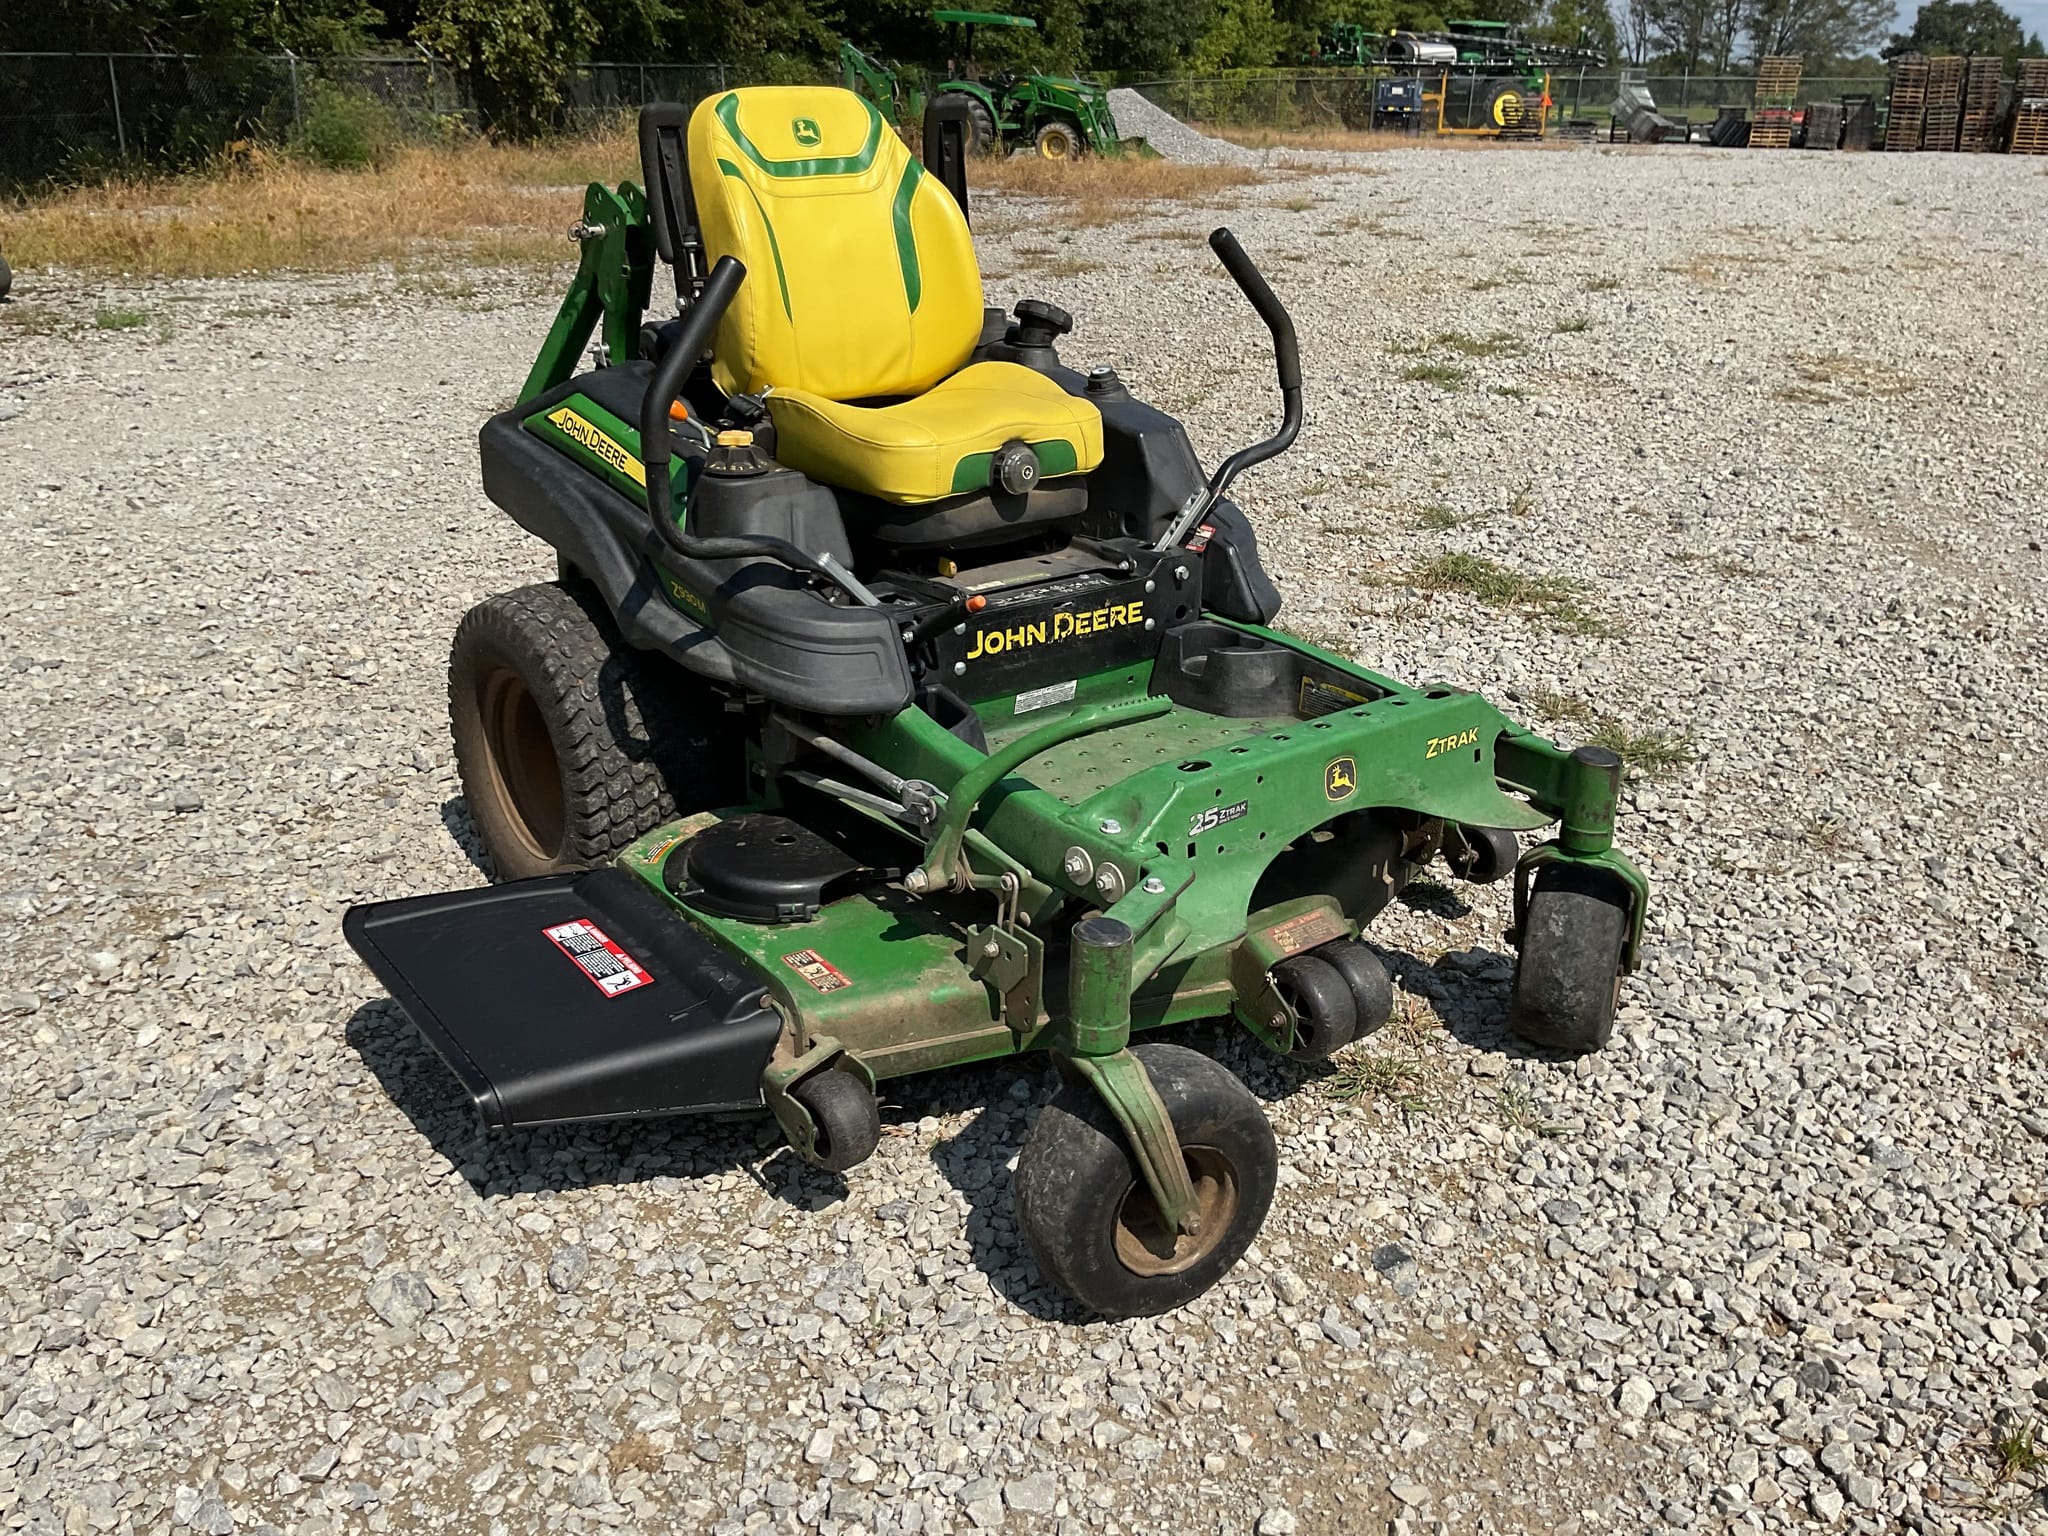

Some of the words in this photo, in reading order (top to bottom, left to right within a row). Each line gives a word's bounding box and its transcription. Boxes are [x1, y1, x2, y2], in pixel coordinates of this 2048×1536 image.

[557, 411, 590, 446] JOHN
[589, 429, 628, 471] DEERE
[966, 621, 1046, 660] JOHN
[1054, 600, 1144, 641] DEERE
[1425, 726, 1479, 760] ZTRAK
[1188, 806, 1219, 836] 25
